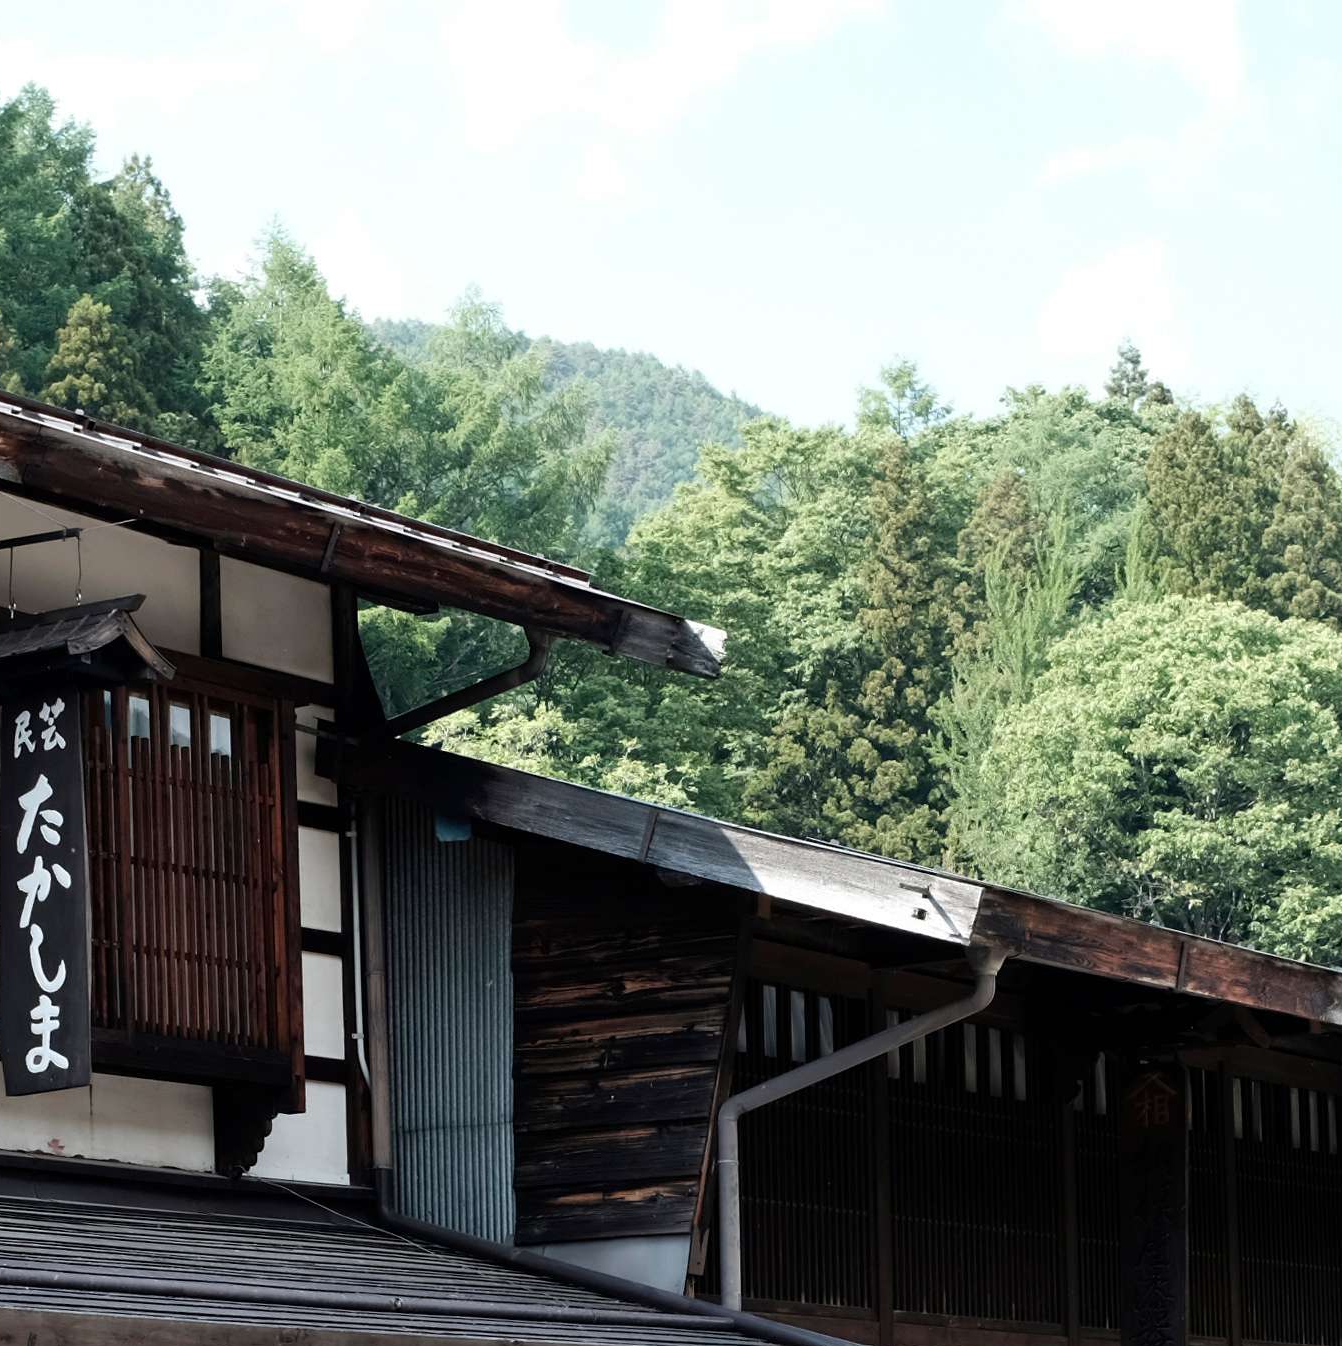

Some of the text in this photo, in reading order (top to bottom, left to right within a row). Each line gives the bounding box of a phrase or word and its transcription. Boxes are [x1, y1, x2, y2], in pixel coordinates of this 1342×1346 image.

[13, 697, 66, 760] 民芸
[16, 773, 72, 1075] たかしま
